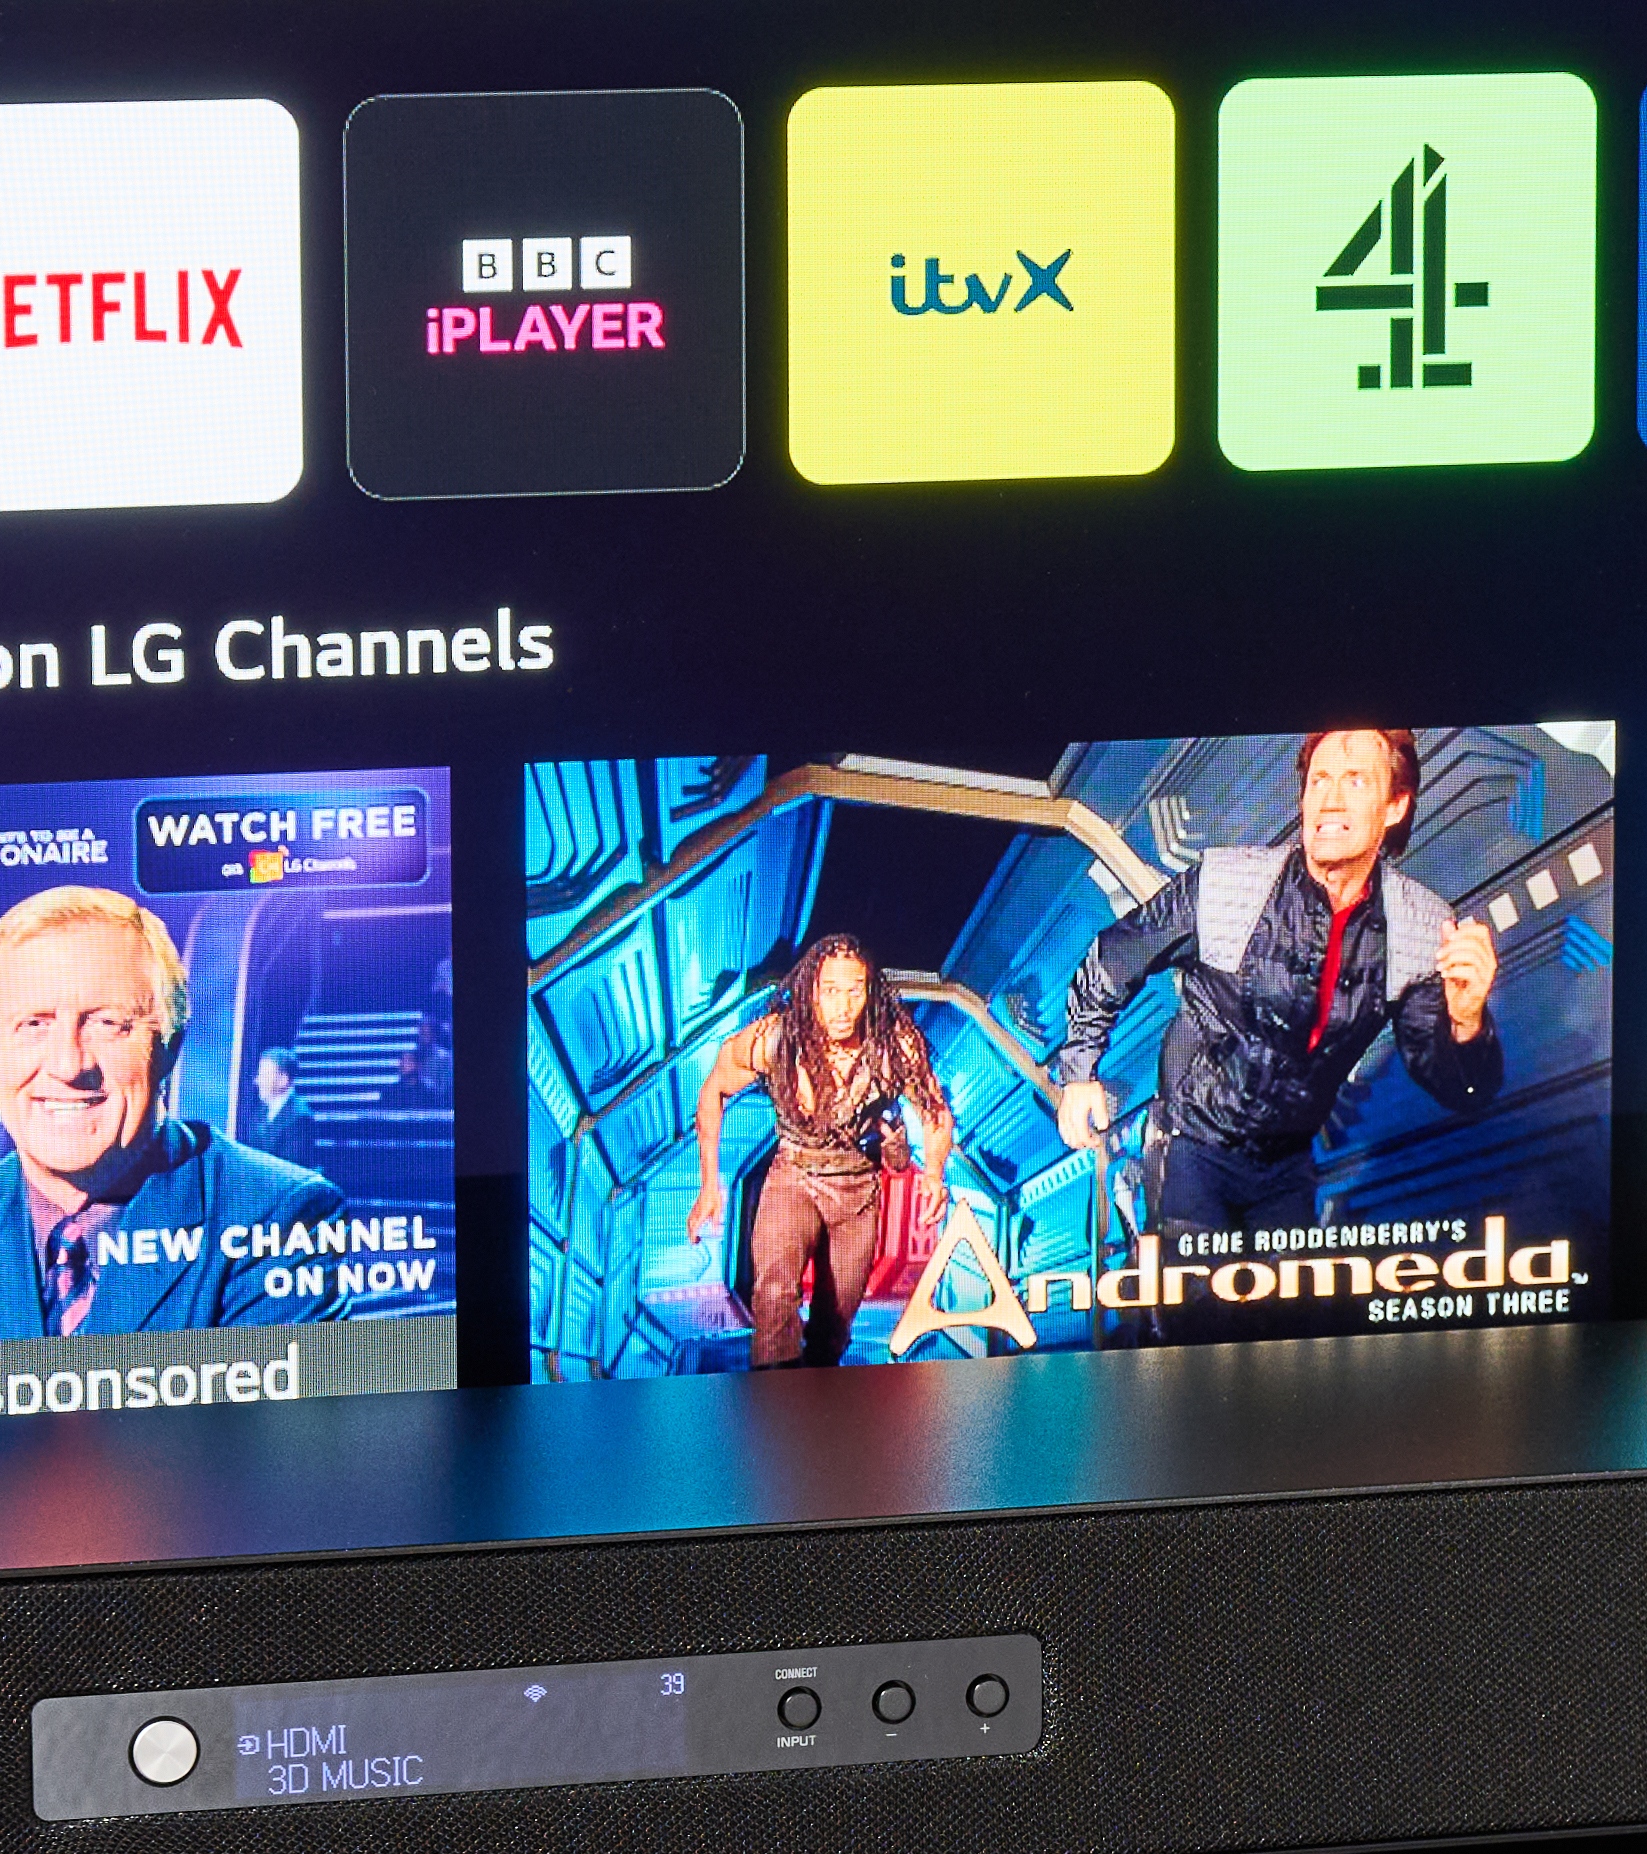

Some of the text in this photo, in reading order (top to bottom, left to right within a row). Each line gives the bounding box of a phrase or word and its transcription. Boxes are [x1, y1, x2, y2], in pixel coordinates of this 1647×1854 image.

[467, 240, 625, 287] BBC
[1315, 142, 1489, 389] 4
[427, 301, 666, 354] iPLAYER
[91, 622, 185, 687] LG
[214, 607, 555, 681] Channels
[147, 805, 416, 847] WATCH FREE
[97, 1215, 436, 1267] NEW CHANNEL
[1178, 1218, 1467, 1257] GENE RODDENBERRY'S
[264, 1259, 436, 1298] ON NOW
[888, 1198, 1571, 1356] Andromeda
[1368, 1288, 1570, 1322] SEASON THREE
[660, 1672, 684, 1697] 39
[775, 1667, 818, 1680] CONNECT
[267, 1724, 347, 1759] HDMI
[776, 1735, 816, 1749] INPUT
[267, 1755, 424, 1796] 3D MUSIC
